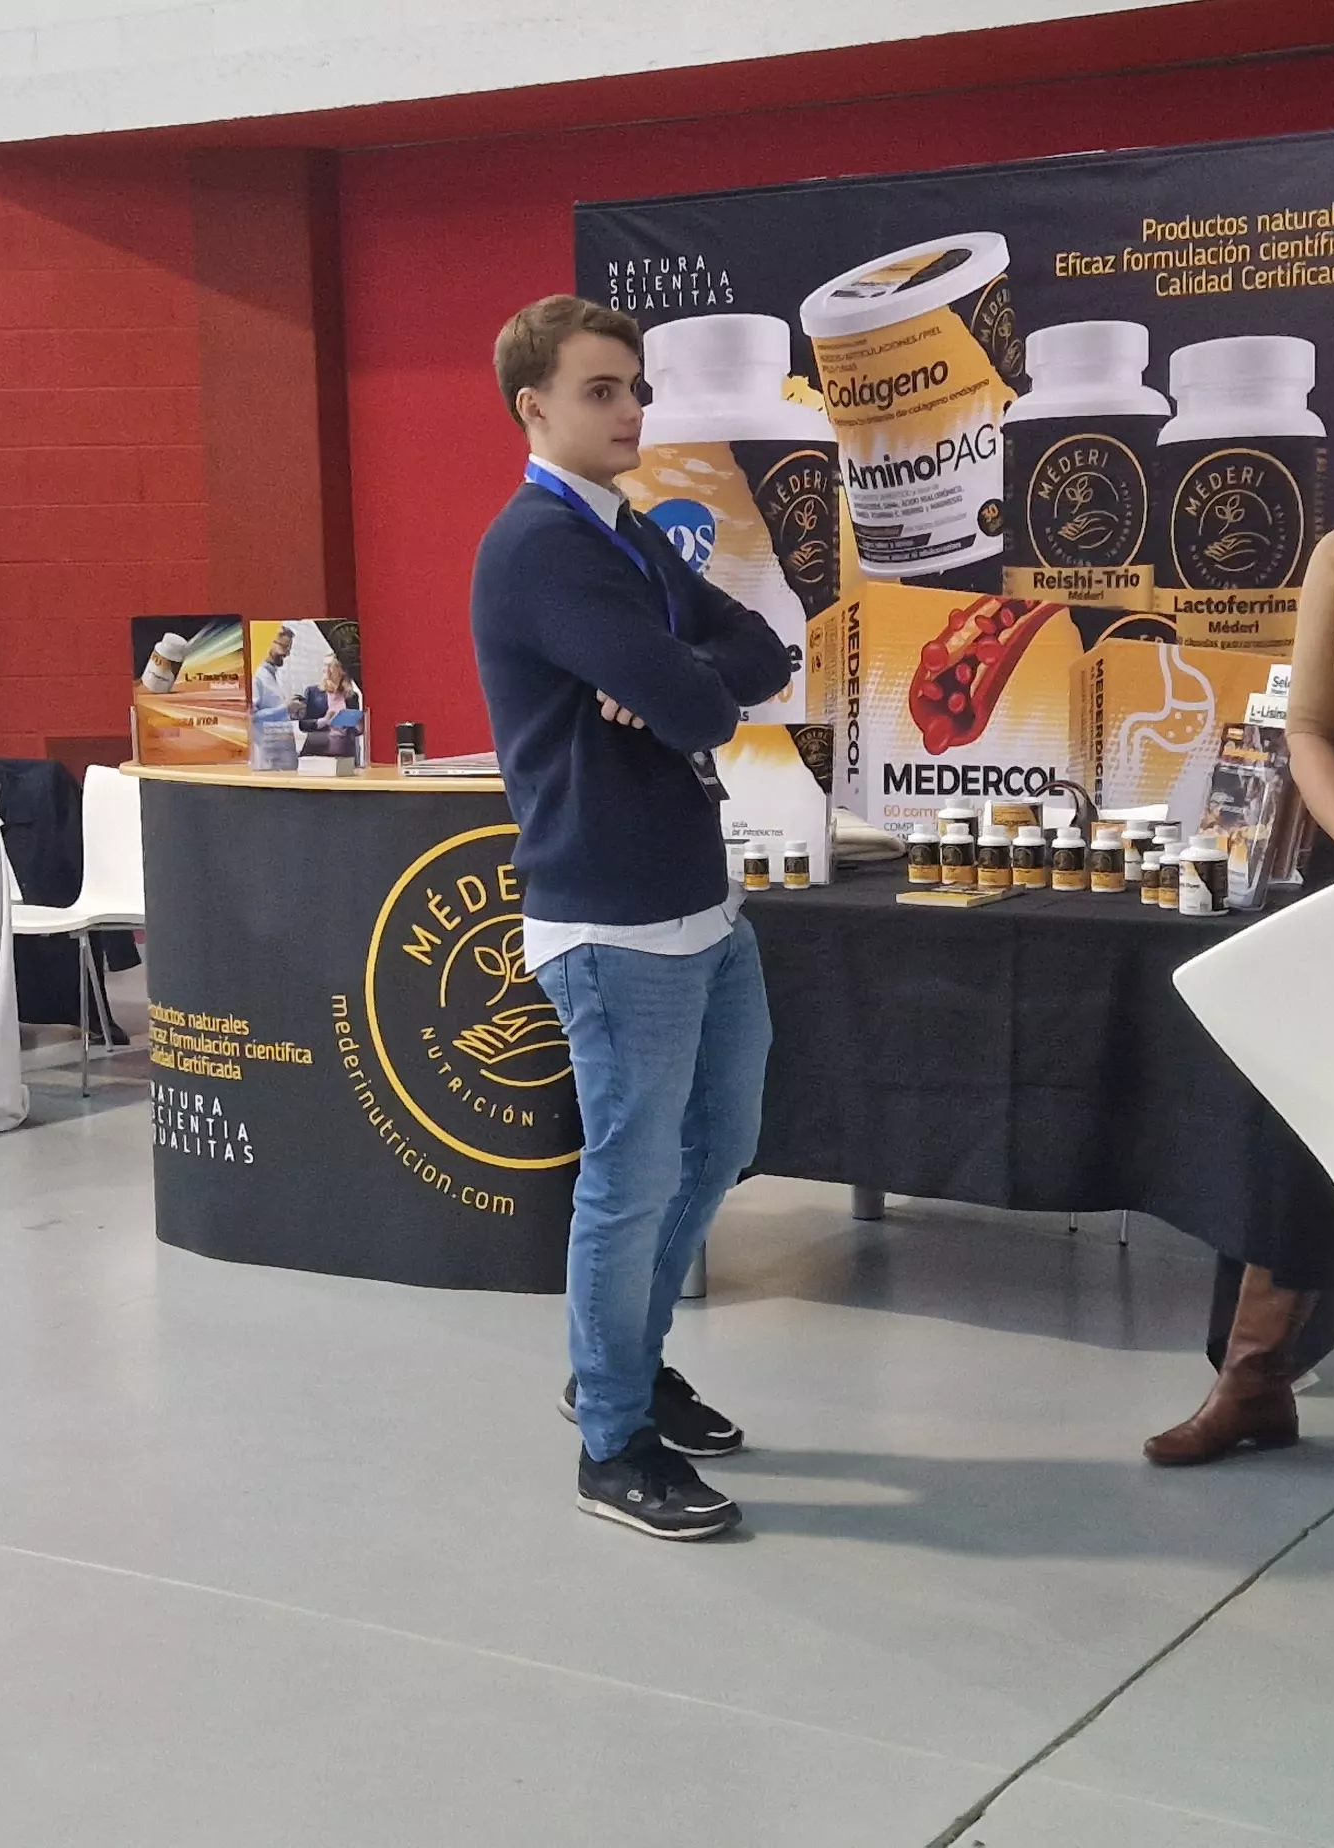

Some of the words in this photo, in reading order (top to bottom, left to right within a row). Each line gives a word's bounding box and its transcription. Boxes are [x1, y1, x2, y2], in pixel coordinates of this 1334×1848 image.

[1142, 214, 1248, 243] Productos
[609, 254, 705, 277] NATURA
[1055, 251, 1116, 277] Eficaz
[1122, 238, 1251, 272] formulación
[610, 270, 729, 294] SCIENTIA
[1155, 267, 1233, 297] Calidad
[827, 360, 948, 411] Colágeno
[848, 423, 996, 490] AminoPAG
[1037, 448, 1109, 500] MÉDERI
[1184, 465, 1265, 517] MÉDERI
[1033, 569, 1140, 590] Reishi-Trio
[1174, 594, 1297, 614] Lactoferrina
[848, 601, 860, 784] MEDERCOL
[883, 763, 1065, 797] MEDERCOL
[402, 863, 520, 966] MÉDE
[188, 1012, 250, 1036] naturales
[169, 1027, 240, 1058] formulación
[244, 1038, 314, 1065] científica
[177, 1051, 243, 1080] Certificada
[420, 1026, 534, 1127] NUTRICIÓN
[331, 993, 515, 1217] mederinutricion.com
